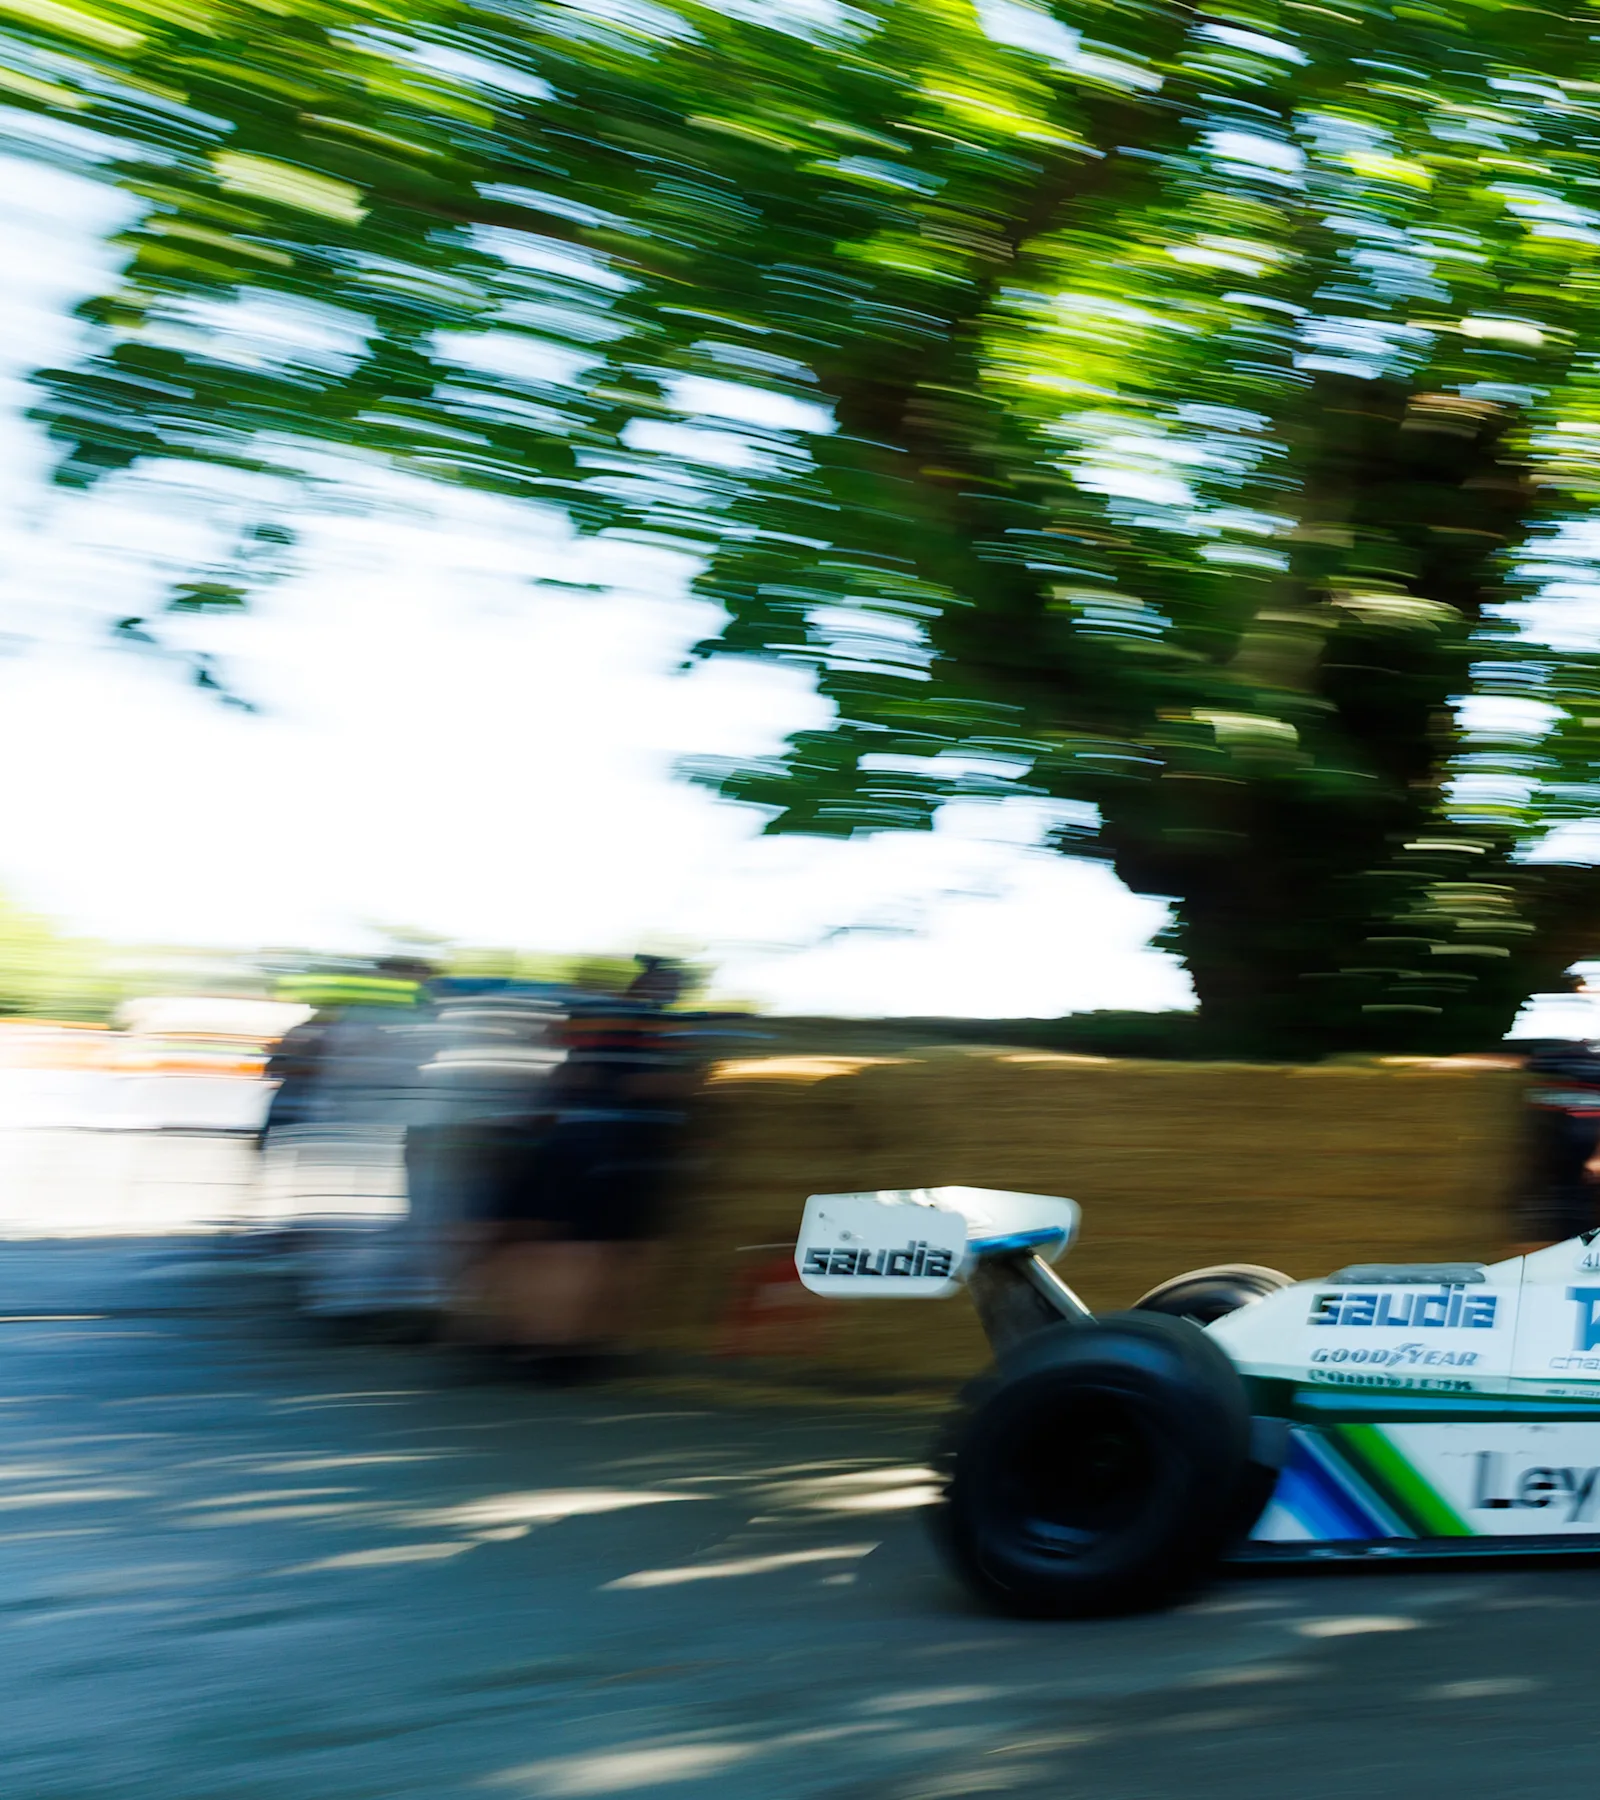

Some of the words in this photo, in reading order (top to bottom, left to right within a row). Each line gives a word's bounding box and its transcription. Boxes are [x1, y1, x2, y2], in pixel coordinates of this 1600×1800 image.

[802, 1240, 952, 1277] saudia
[1307, 1284, 1497, 1328] saudia
[1310, 1346, 1479, 1367] GOODYEAR
